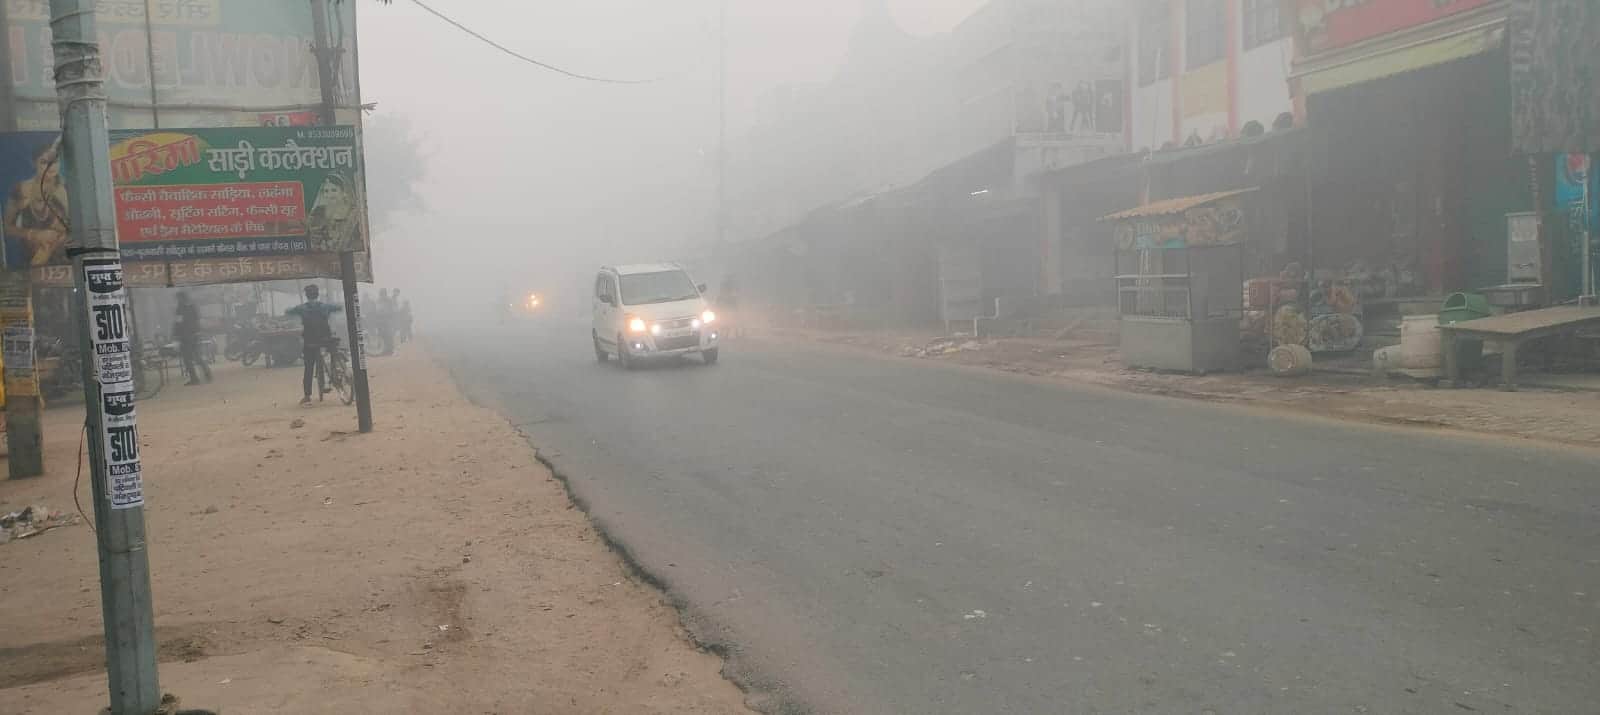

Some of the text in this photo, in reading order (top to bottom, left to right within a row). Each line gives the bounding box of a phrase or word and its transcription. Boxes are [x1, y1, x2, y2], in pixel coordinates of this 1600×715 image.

[206, 140, 256, 180] साड़ी
[258, 139, 354, 170] कलैक्शन
[98, 343, 121, 354] Mob.
[111, 463, 133, 475] Mob.
